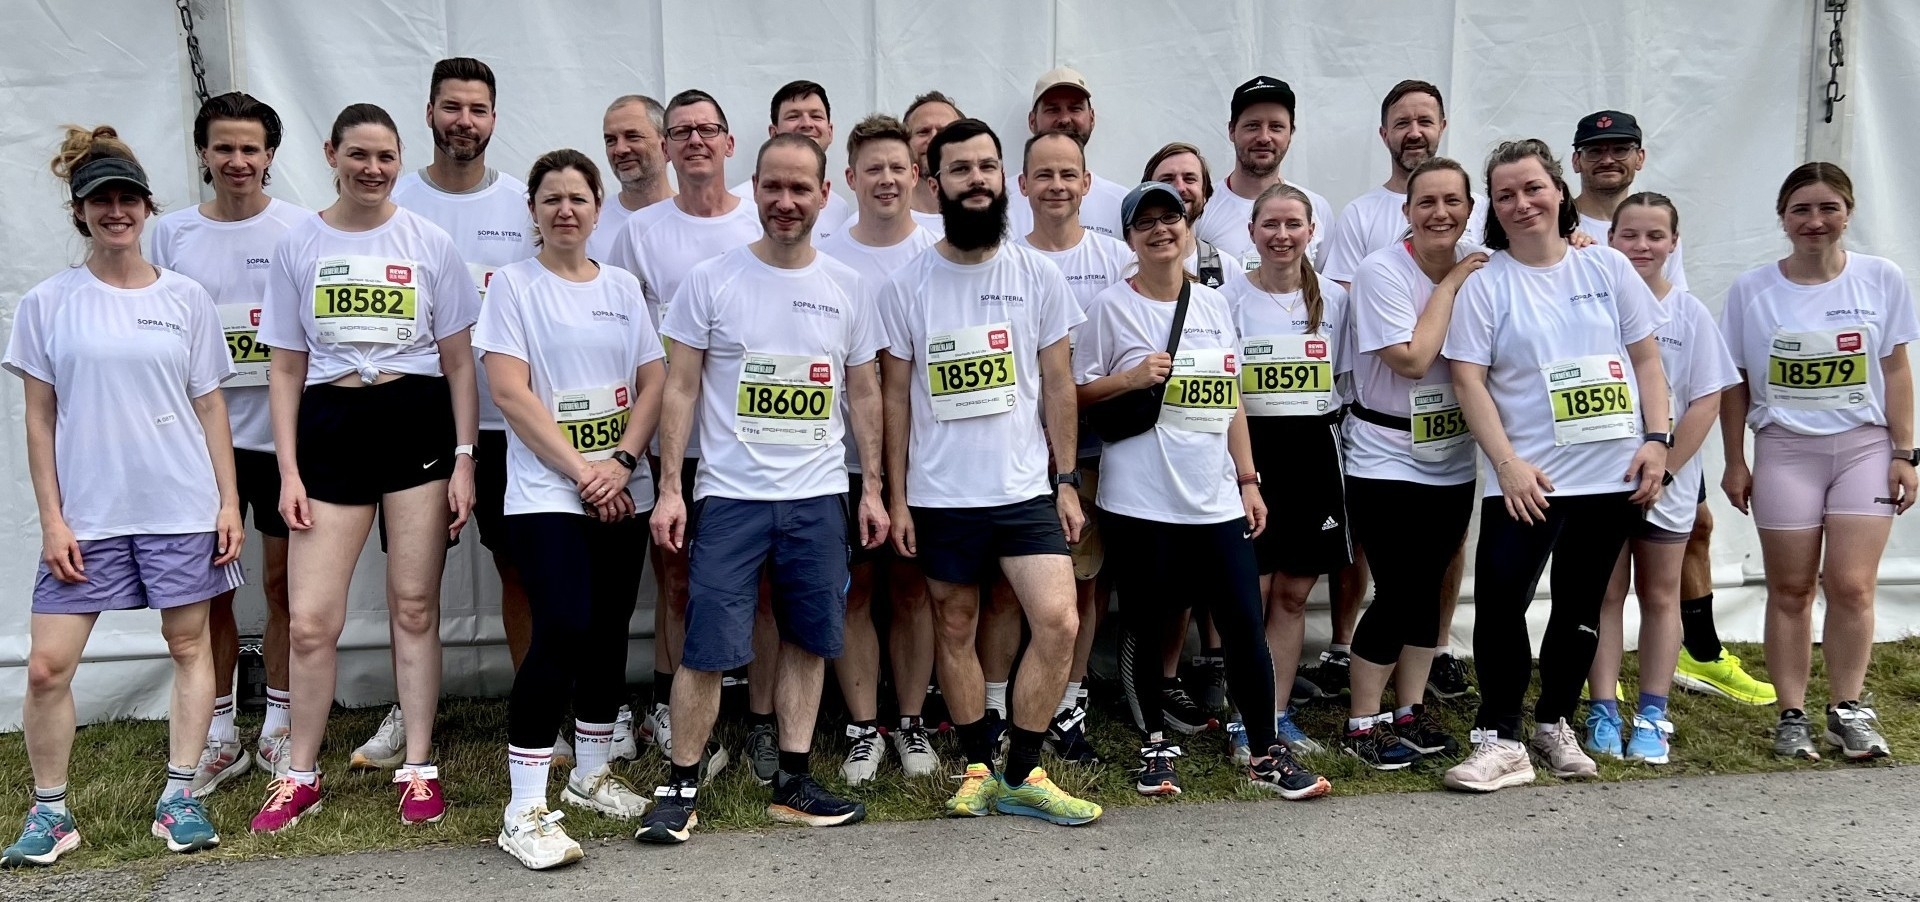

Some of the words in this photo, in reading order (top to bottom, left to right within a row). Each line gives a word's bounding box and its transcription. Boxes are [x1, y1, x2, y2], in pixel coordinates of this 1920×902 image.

[501, 230, 522, 238] STERIA
[325, 288, 404, 315] 18582
[793, 301, 816, 309] SOPRA
[818, 304, 840, 314] STERIA
[137, 318, 164, 326] SOPRA
[226, 335, 271, 359] 594
[937, 358, 1009, 391] 18593
[1254, 365, 1319, 390] 18591
[1778, 359, 1855, 386] 18579
[746, 386, 826, 416] 18600
[955, 397, 1000, 408] PORSCHE
[1179, 379, 1233, 405] 18581
[1562, 386, 1627, 416] 18596
[1423, 411, 1466, 438] 1859
